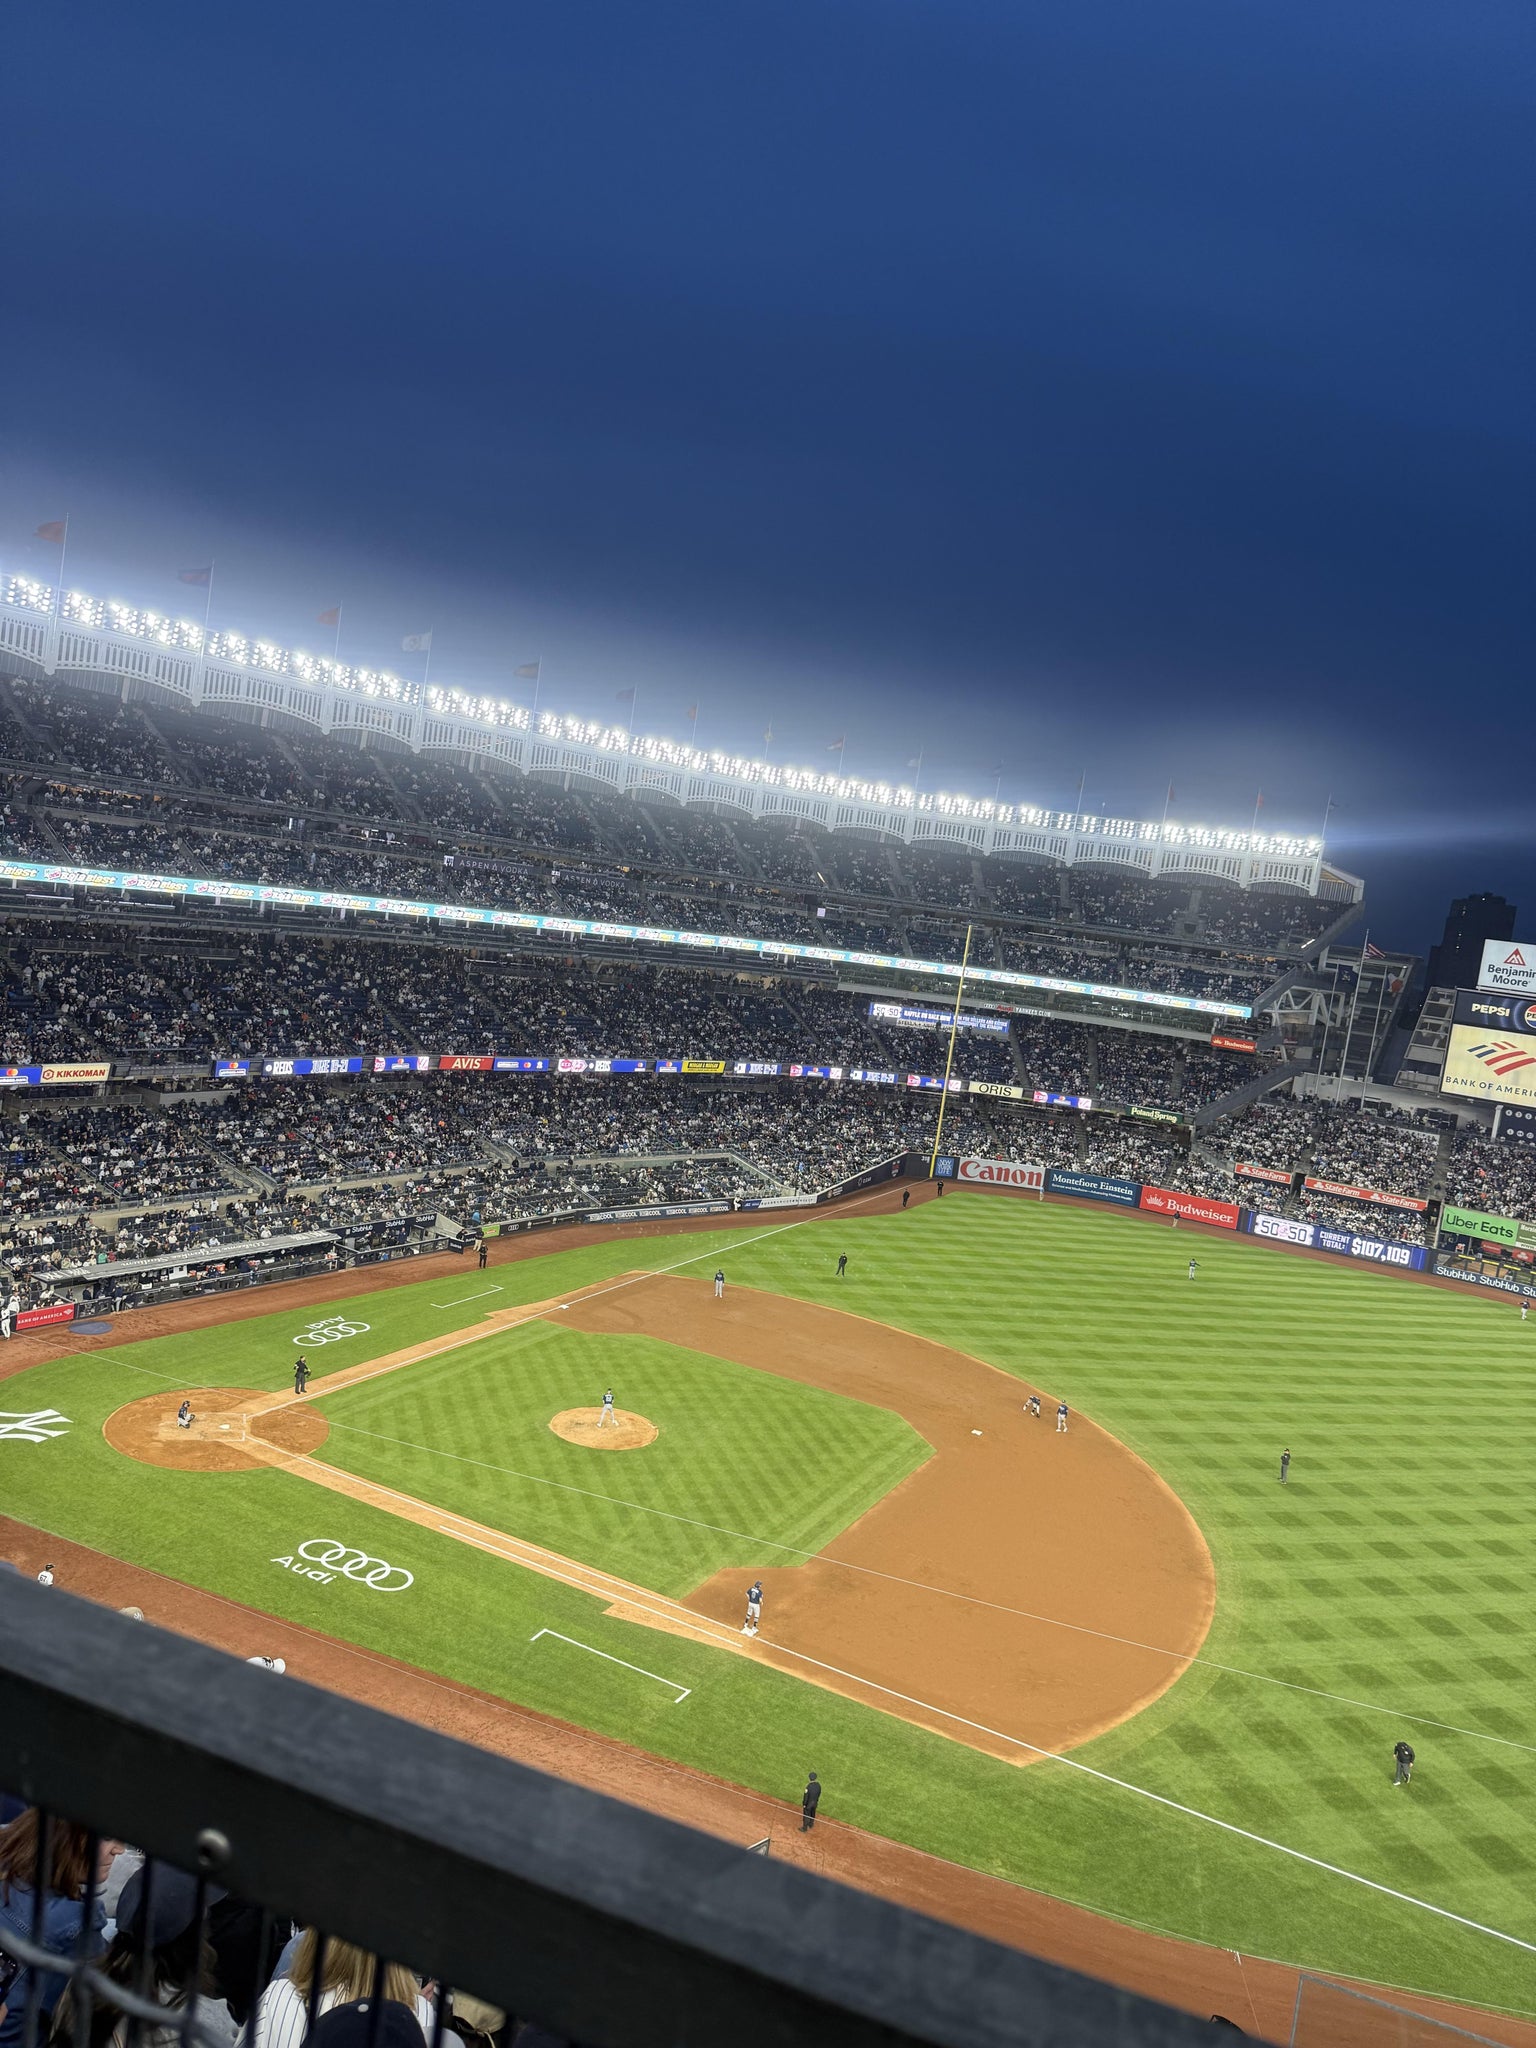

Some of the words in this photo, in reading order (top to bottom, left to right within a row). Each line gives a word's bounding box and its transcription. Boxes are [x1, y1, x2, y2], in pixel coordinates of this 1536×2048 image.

[459, 860, 490, 870] ASPEN
[500, 865, 529, 875] VODKA
[1492, 974, 1528, 987] Moore
[1471, 1003, 1511, 1017] PEPSI
[1224, 1040, 1254, 1050] Budweiser
[273, 1061, 294, 1074] REDS
[451, 1058, 481, 1069] AVIS
[56, 1069, 106, 1078] KIKKOMAN
[978, 1083, 1012, 1097] ORIS
[1445, 1076, 1476, 1088] BANK
[1479, 1081, 1494, 1090] OF
[1131, 1107, 1154, 1118] Poland
[1154, 1111, 1178, 1123] Spring
[960, 1160, 1042, 1187] Canon
[1052, 1173, 1098, 1189] Montefiore
[1100, 1181, 1133, 1196] Einstein
[1166, 1199, 1234, 1224] Budweiser
[385, 1219, 405, 1228] StubHub
[415, 1215, 435, 1223] StubHub
[1446, 1213, 1479, 1230] Uber
[1480, 1221, 1514, 1238] Eats
[352, 1225, 373, 1233] StubHub
[1261, 1220, 1278, 1235] 50
[1287, 1226, 1307, 1242] 50
[1319, 1231, 1350, 1243] CURRENT
[1322, 1240, 1346, 1250] TOTAL:
[1351, 1236, 1411, 1265] $107,109
[1436, 1266, 1476, 1282] StubHub
[1479, 1275, 1519, 1293] StubHub
[40, 1312, 63, 1320] AMERICA
[270, 1555, 338, 1585] Audi
